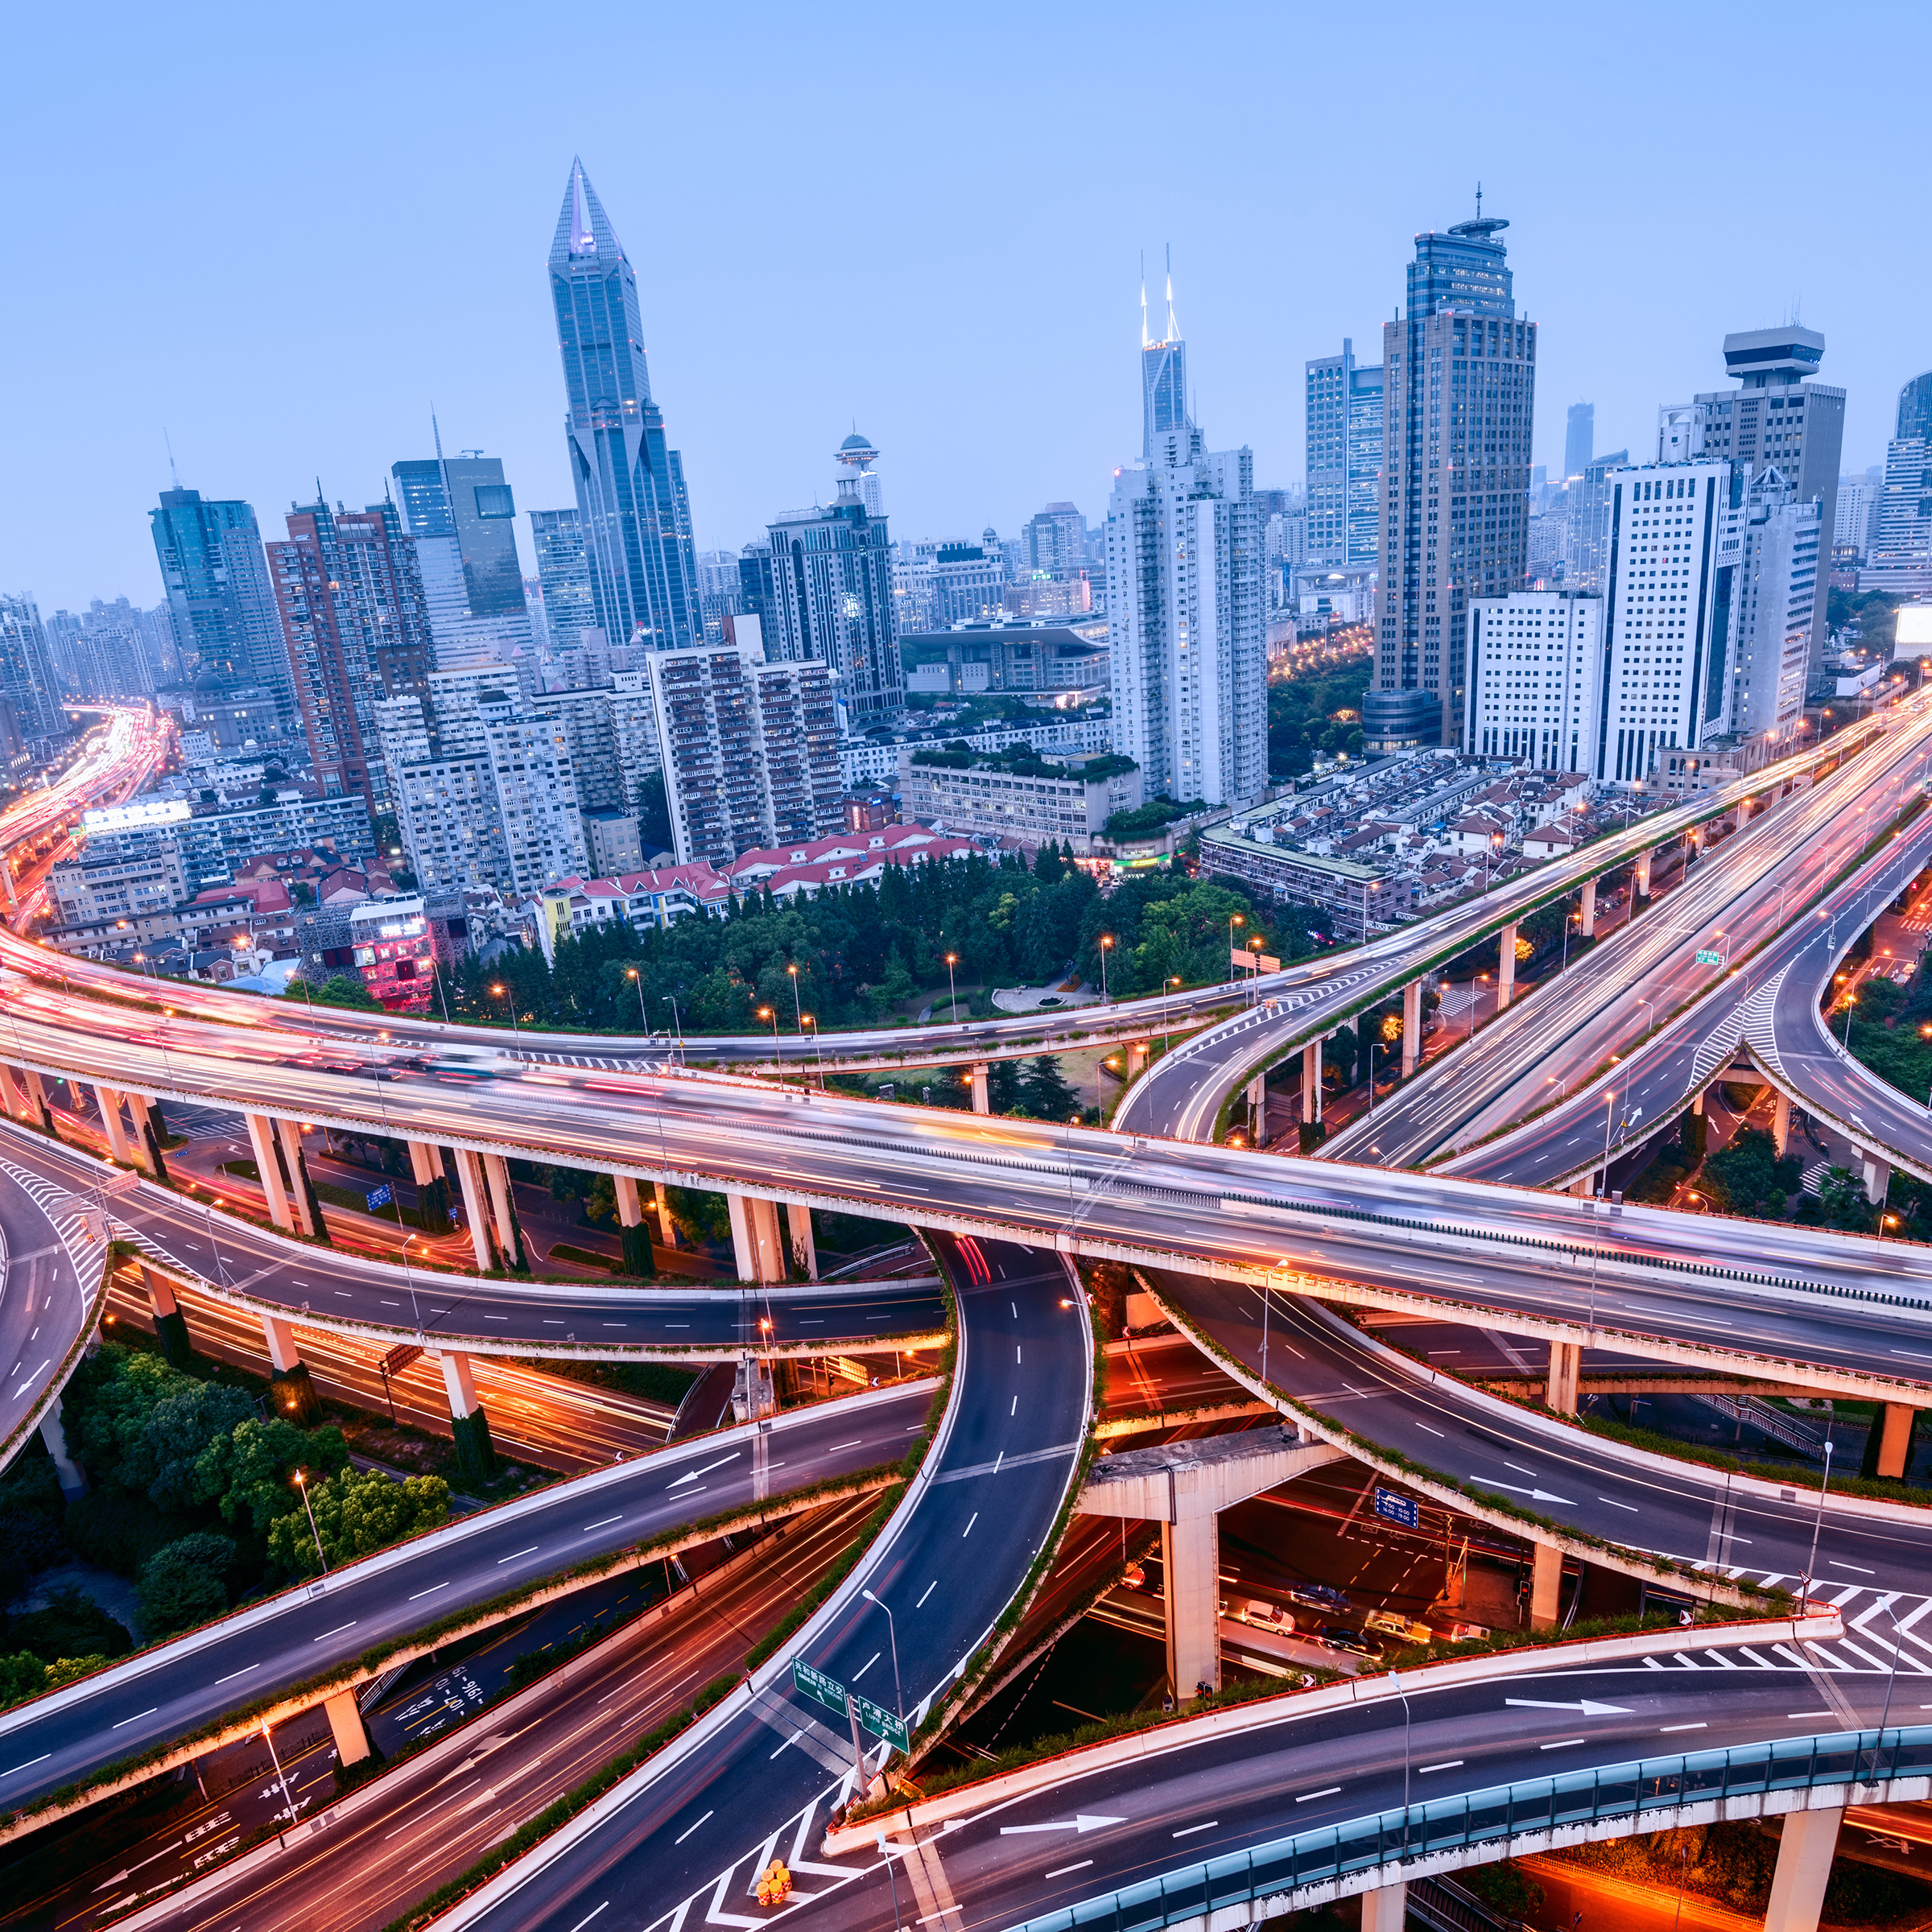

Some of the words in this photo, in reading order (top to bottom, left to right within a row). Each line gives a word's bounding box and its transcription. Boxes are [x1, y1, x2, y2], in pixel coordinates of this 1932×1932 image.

[795, 1661, 843, 1697] 共和新路立交
[862, 1701, 904, 1732] 卢浦大桥
[881, 1720, 902, 1737] BRIDGE
